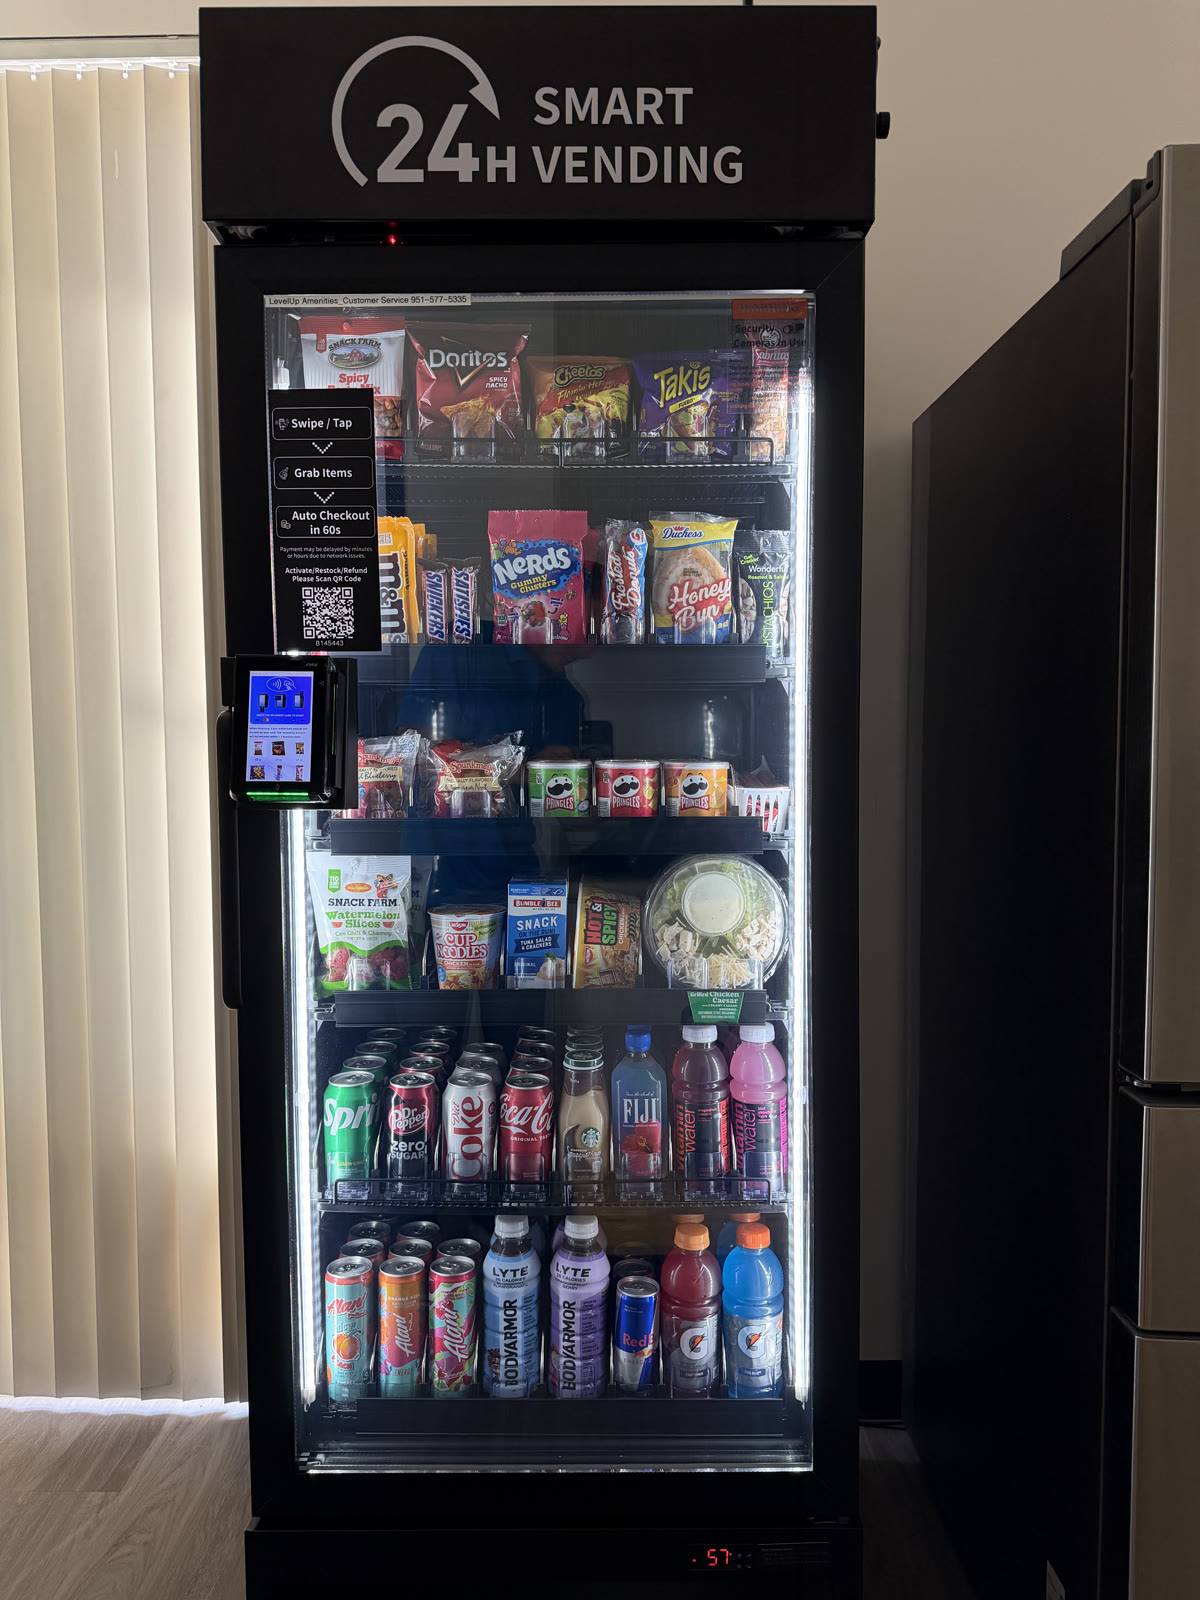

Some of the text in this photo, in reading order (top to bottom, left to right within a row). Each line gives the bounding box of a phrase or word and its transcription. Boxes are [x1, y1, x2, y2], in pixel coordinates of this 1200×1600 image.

[533, 86, 694, 126] SMART
[532, 145, 744, 185] VENDING
[269, 295, 467, 306] LevelUp Amenities_Customer Service 951-577-5335
[741, 302, 799, 313] WARNING
[735, 323, 775, 336] Security
[328, 338, 357, 352] SNACK
[358, 337, 382, 350] FARM
[733, 338, 807, 348] Cameras In Use
[429, 349, 509, 368] Doritos
[755, 348, 790, 361] Sabritas
[338, 373, 370, 386] Spicy
[555, 365, 606, 387] Cheetos
[653, 361, 712, 409] Takis
[291, 418, 324, 431] Swipe
[333, 418, 353, 430] Tap
[294, 467, 353, 478] Grab Items
[292, 510, 370, 521] Auto Checkout
[309, 524, 342, 535] in 60s
[661, 527, 704, 539] Duchess
[285, 567, 368, 575] Activate/Restock/Refund
[622, 545, 642, 608] Donuts
[748, 565, 790, 573] Wonderful
[333, 575, 343, 584] QR
[344, 575, 362, 583] Code
[510, 573, 548, 590] Gummy
[519, 579, 557, 594] Clusters
[608, 553, 630, 610] Frosted
[668, 577, 732, 610] Honey
[425, 571, 446, 640] SNICKERS
[453, 569, 472, 638] SATISFIES
[674, 604, 720, 632] Bun
[546, 795, 574, 811] PRINGLES
[612, 795, 640, 809] PRINGLES
[681, 795, 709, 811] PRINGLES
[328, 898, 398, 907] SNACK FARM
[325, 910, 400, 920] Watermelon
[586, 902, 603, 943] HOT &
[345, 919, 381, 928] Slices
[516, 916, 558, 931] SNACK
[602, 903, 618, 944] SPICY
[443, 933, 477, 946] CUP
[525, 941, 552, 950] CRACKERS
[535, 936, 552, 944] SALAD
[437, 944, 488, 959] NOODLES
[401, 1106, 418, 1118] Dr
[622, 1098, 659, 1124] FIJI
[393, 1110, 428, 1131] Pepper
[743, 1105, 757, 1150] water
[684, 1107, 696, 1152] water
[391, 1140, 426, 1151] zero
[452, 1096, 484, 1180] Coke
[390, 1150, 427, 1160] SUGAR
[492, 1266, 529, 1278] LYTE
[555, 1262, 592, 1278] LYTE
[562, 1275, 587, 1283] CALORIES
[327, 1292, 367, 1317] Alani
[392, 1312, 417, 1358] Alani
[441, 1302, 469, 1363] Alani
[622, 1332, 648, 1348] Red
[503, 1298, 518, 1388] BODYARMOR
[561, 1300, 577, 1392] BODYARMOR
[394, 1368, 414, 1376] ENERGY
[707, 1548, 729, 1566] 57
